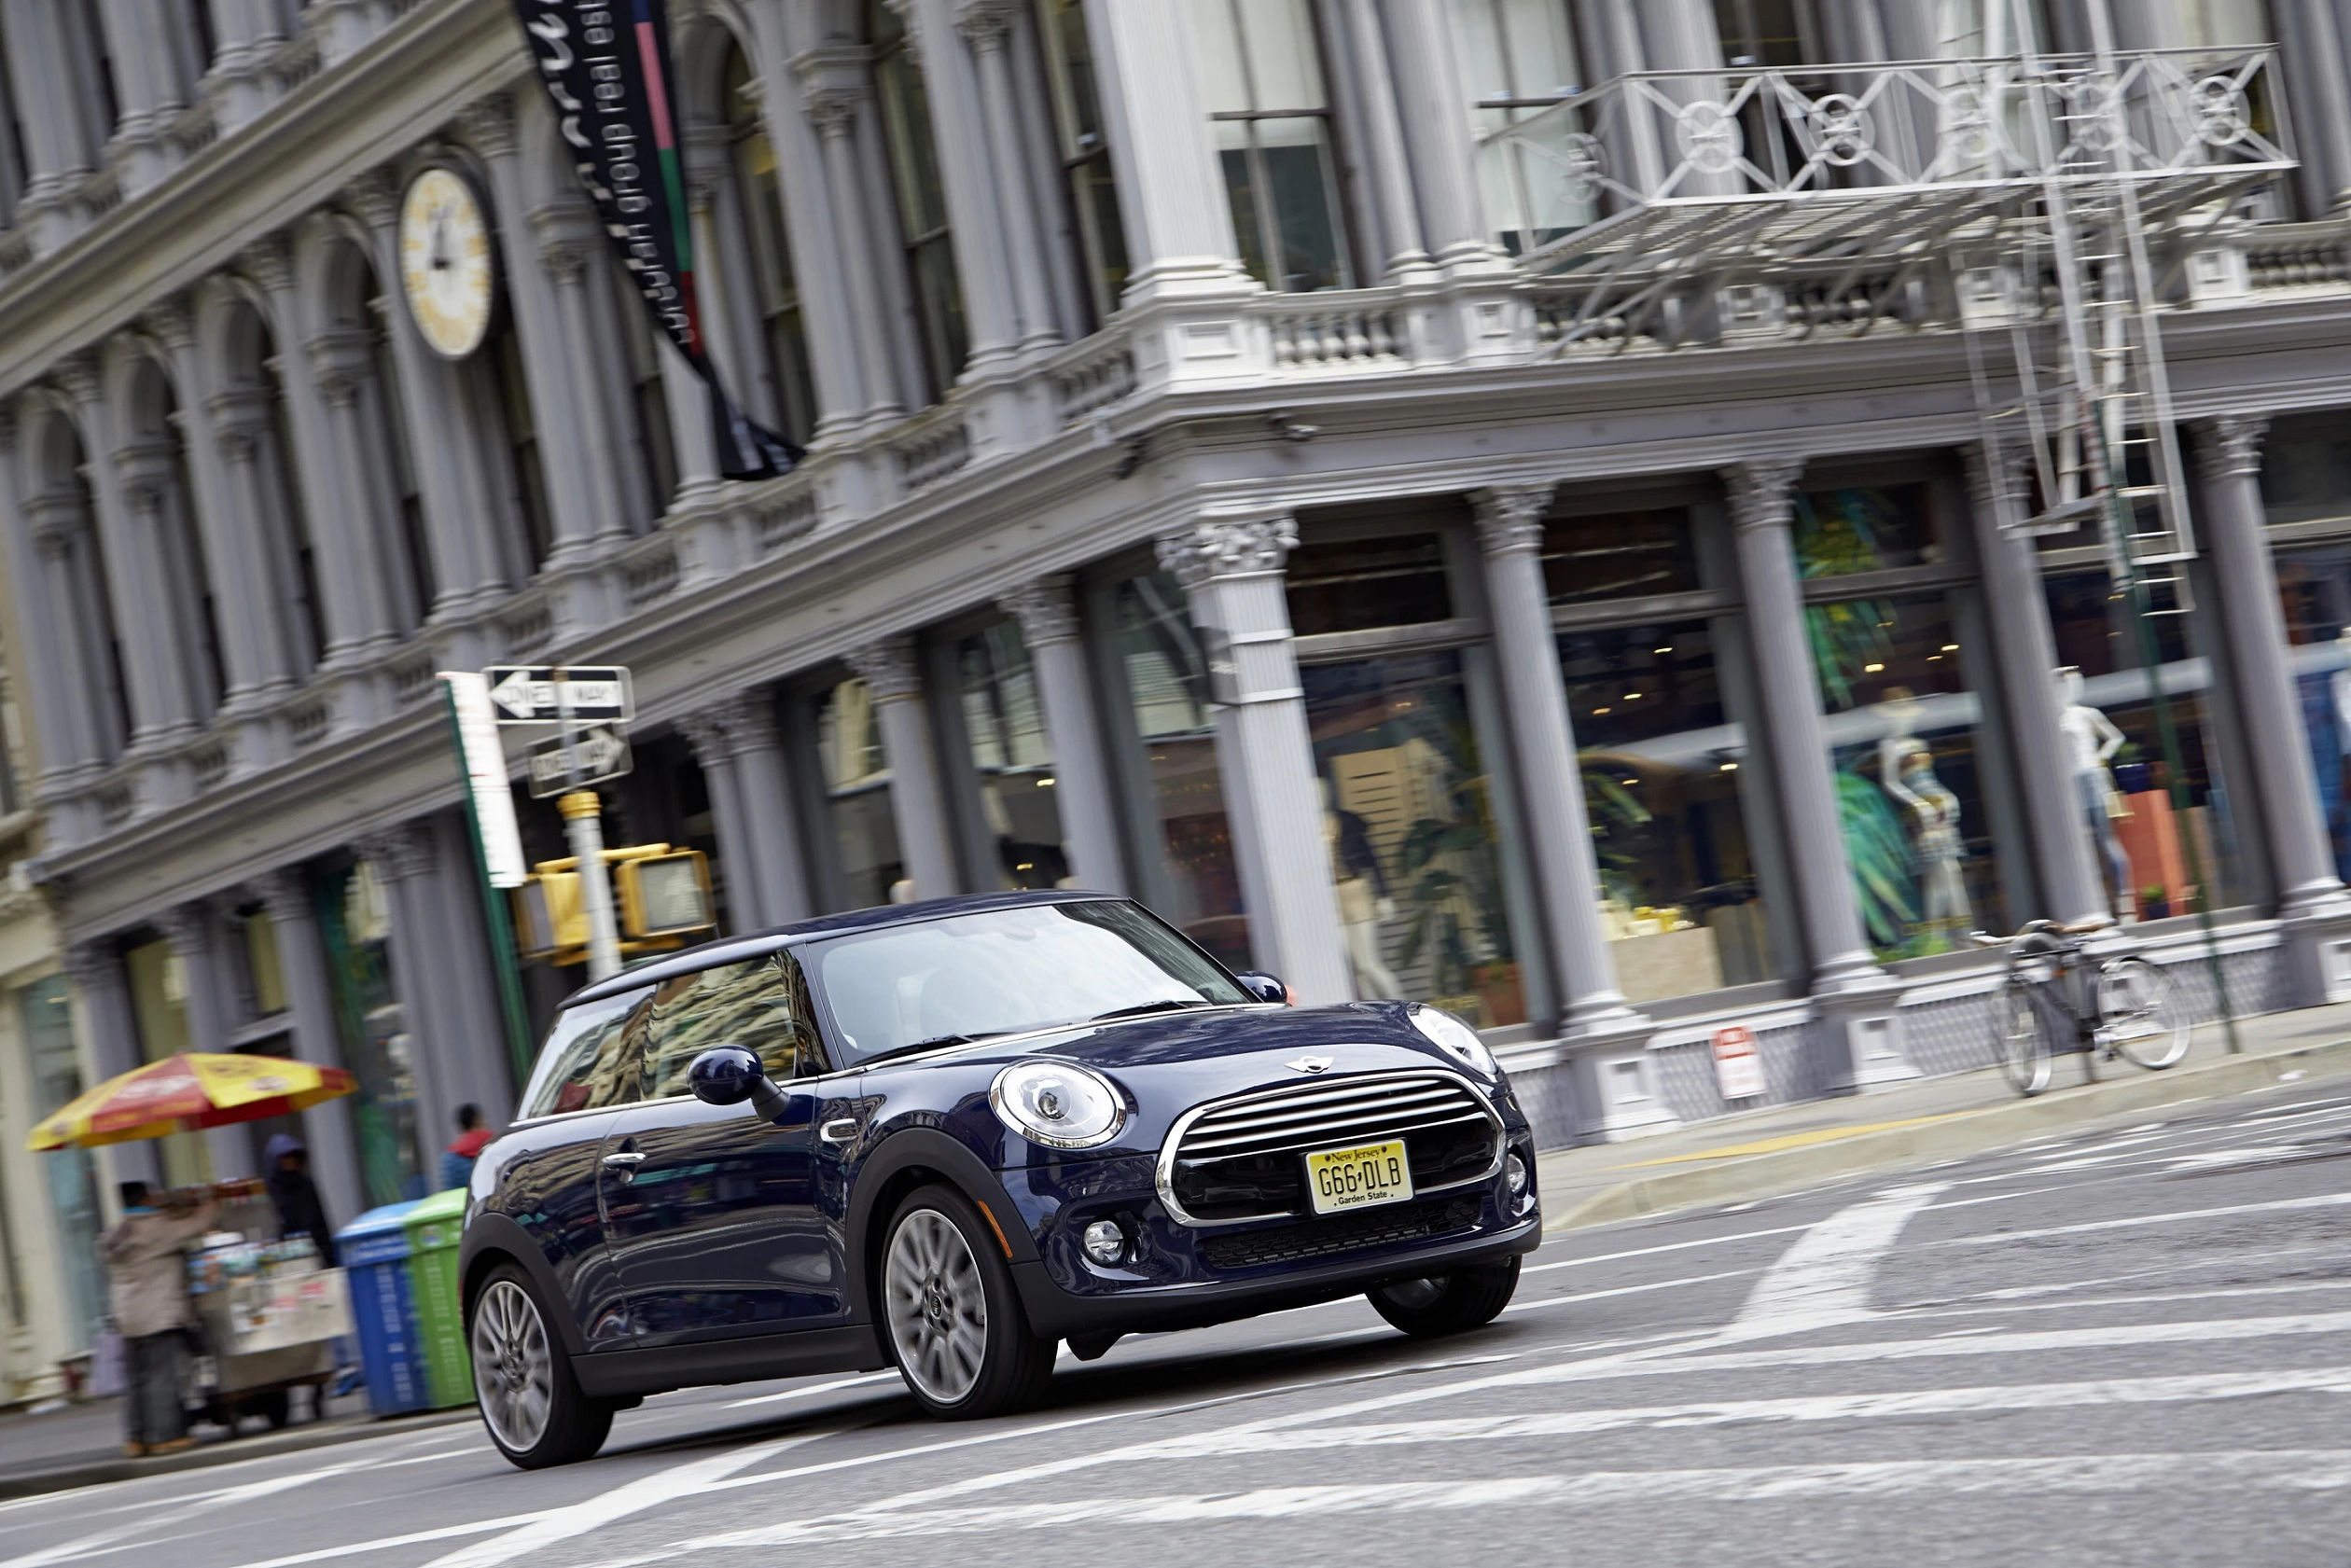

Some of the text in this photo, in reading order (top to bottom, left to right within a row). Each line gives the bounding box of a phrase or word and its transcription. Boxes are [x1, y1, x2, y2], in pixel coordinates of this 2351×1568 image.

[582, 55, 628, 114] real
[601, 123, 653, 214] group
[1331, 1148, 1381, 1163] New Jersey
[1338, 1191, 1388, 1205] Garden State
